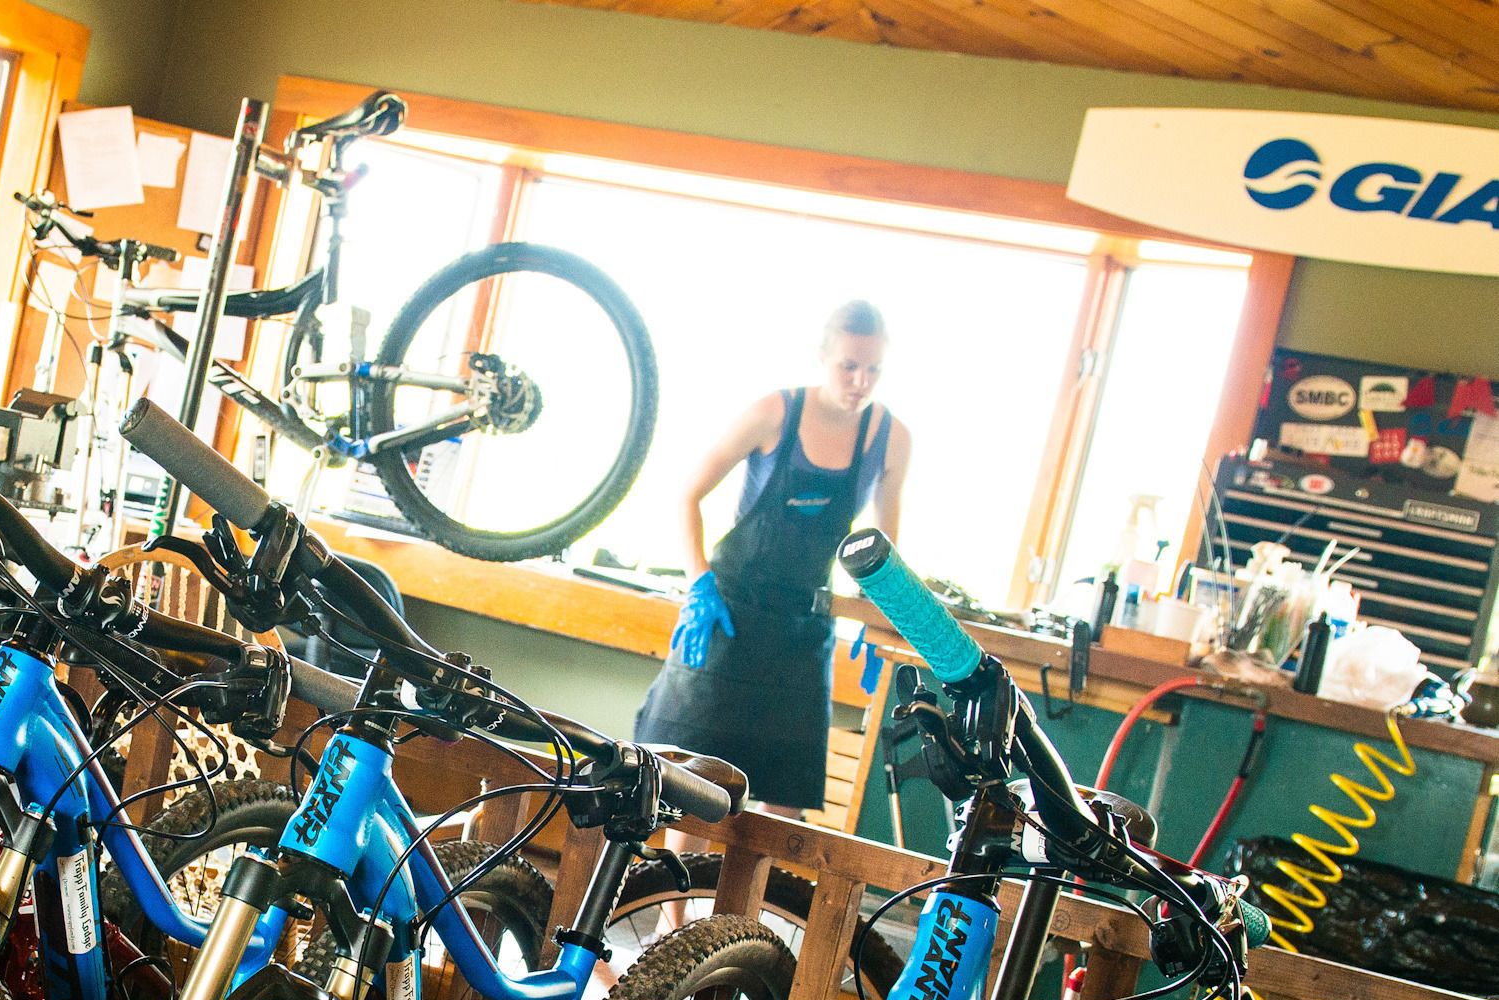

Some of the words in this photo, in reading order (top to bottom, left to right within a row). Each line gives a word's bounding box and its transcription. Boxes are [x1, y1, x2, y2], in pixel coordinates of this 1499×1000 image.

[1296, 388, 1349, 406] SMBC
[293, 739, 357, 848] GIANT
[74, 853, 85, 885] Trapp
[76, 882, 89, 919] Family
[81, 919, 92, 949] Lodge
